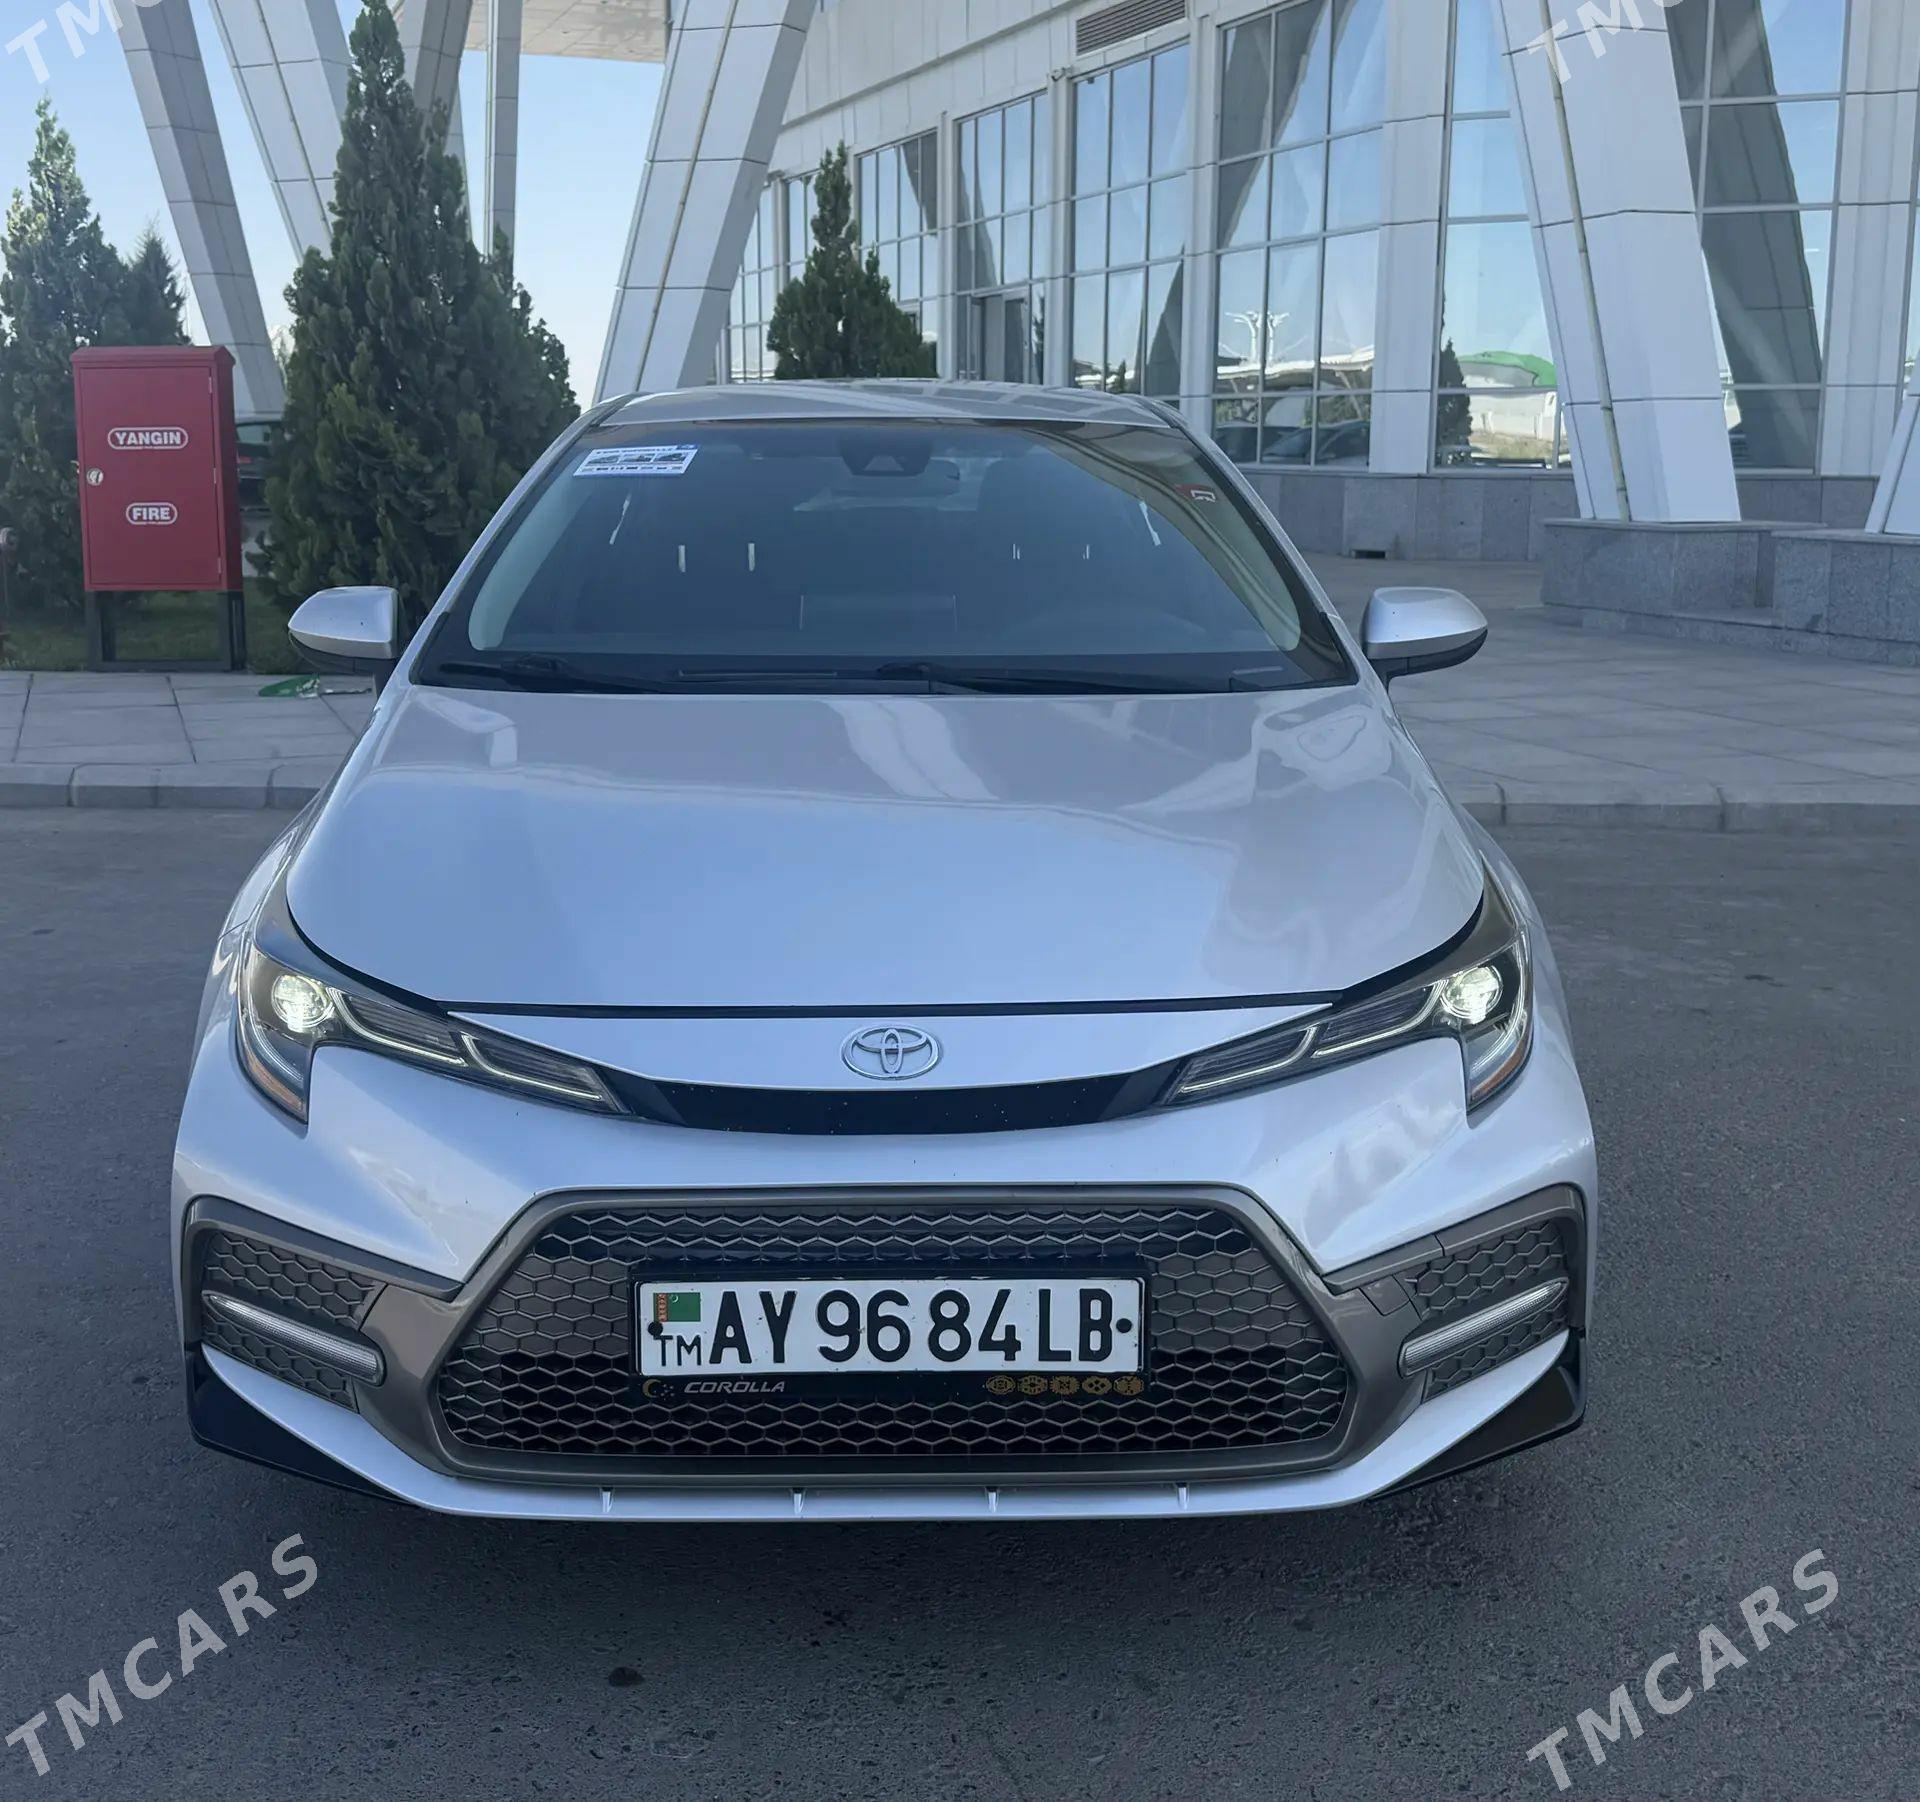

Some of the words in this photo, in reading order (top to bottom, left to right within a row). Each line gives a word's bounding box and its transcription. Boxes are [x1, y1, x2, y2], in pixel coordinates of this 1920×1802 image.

[115, 431, 181, 445] YANGIN
[132, 507, 171, 521] FIRE
[653, 1335, 702, 1367] TM
[683, 1380, 786, 1395] COROLLA
